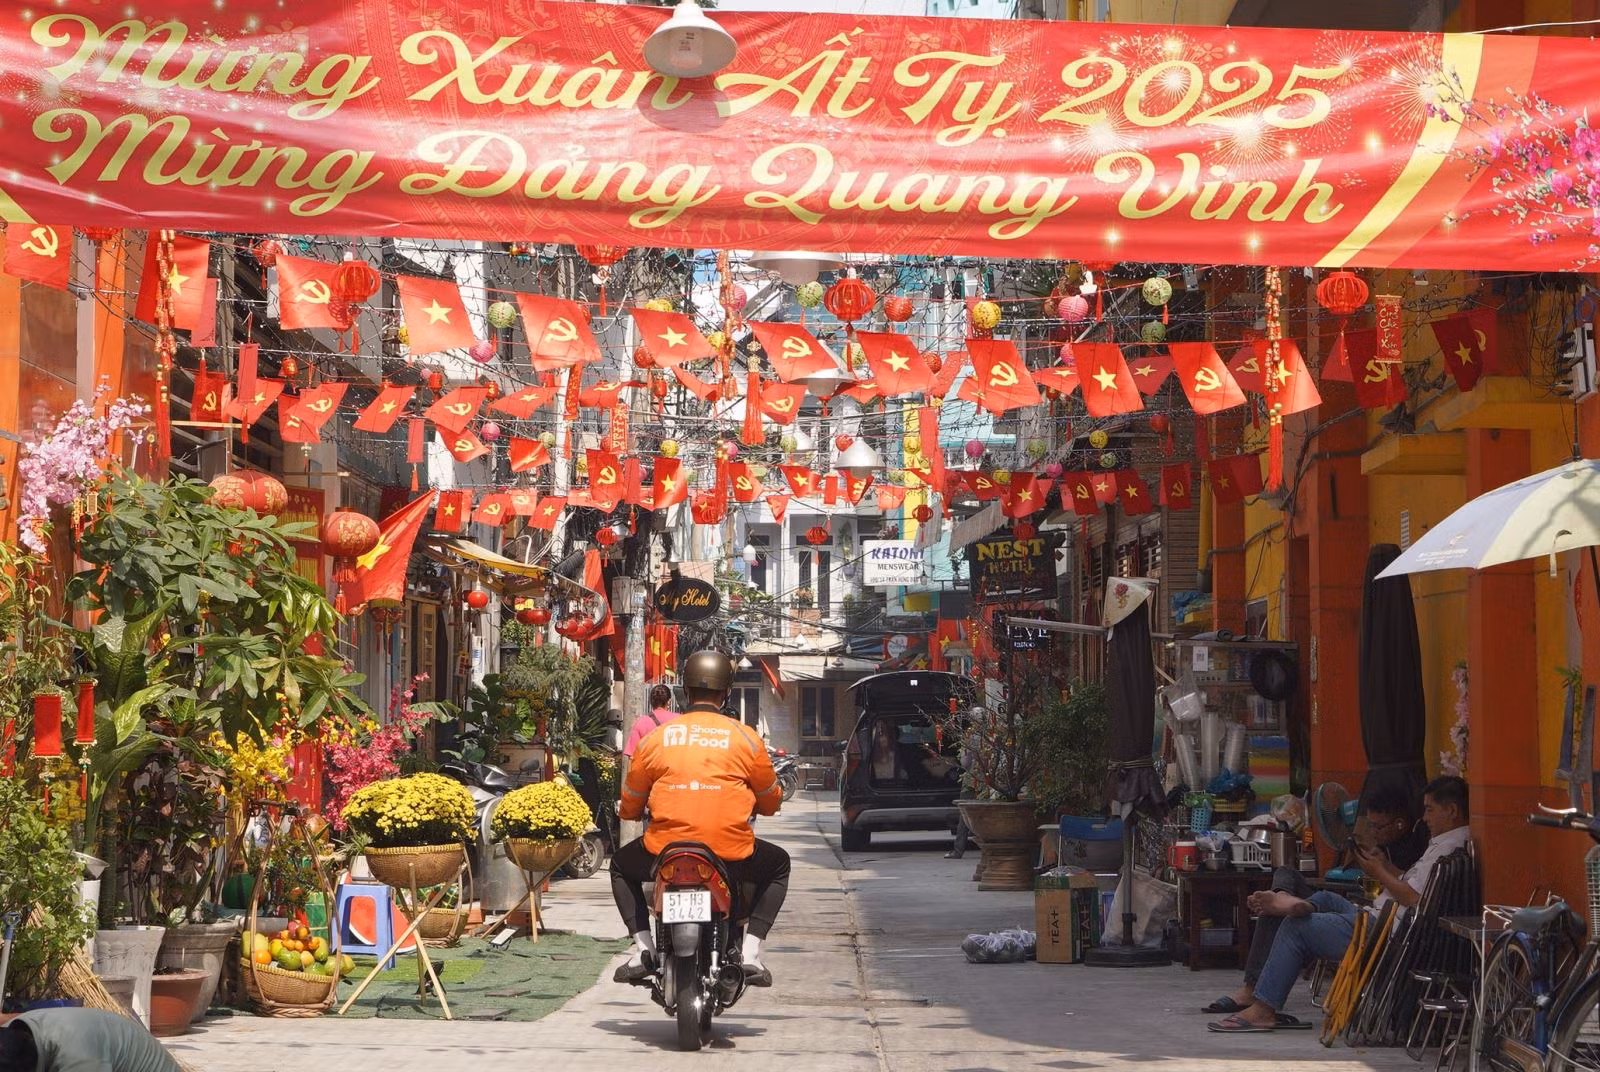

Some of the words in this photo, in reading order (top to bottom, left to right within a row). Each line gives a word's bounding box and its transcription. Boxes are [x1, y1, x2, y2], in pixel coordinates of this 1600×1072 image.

[30, 13, 382, 121] Mừng
[399, 30, 694, 111] Xuân
[714, 26, 875, 119] Ất
[893, 50, 1022, 148] Tỵ
[1037, 55, 1347, 129] 2025
[32, 108, 384, 217] Mừng
[399, 129, 722, 229] Đảng
[743, 141, 1080, 241] Quang
[1093, 151, 1345, 224] Vinh
[975, 538, 1046, 562] NEST
[877, 562, 919, 571] MENSWEAR
[681, 588, 712, 607] Hotel
[690, 724, 731, 737] Shopee
[688, 733, 730, 750] Food
[1050, 909, 1060, 946] TEA+
